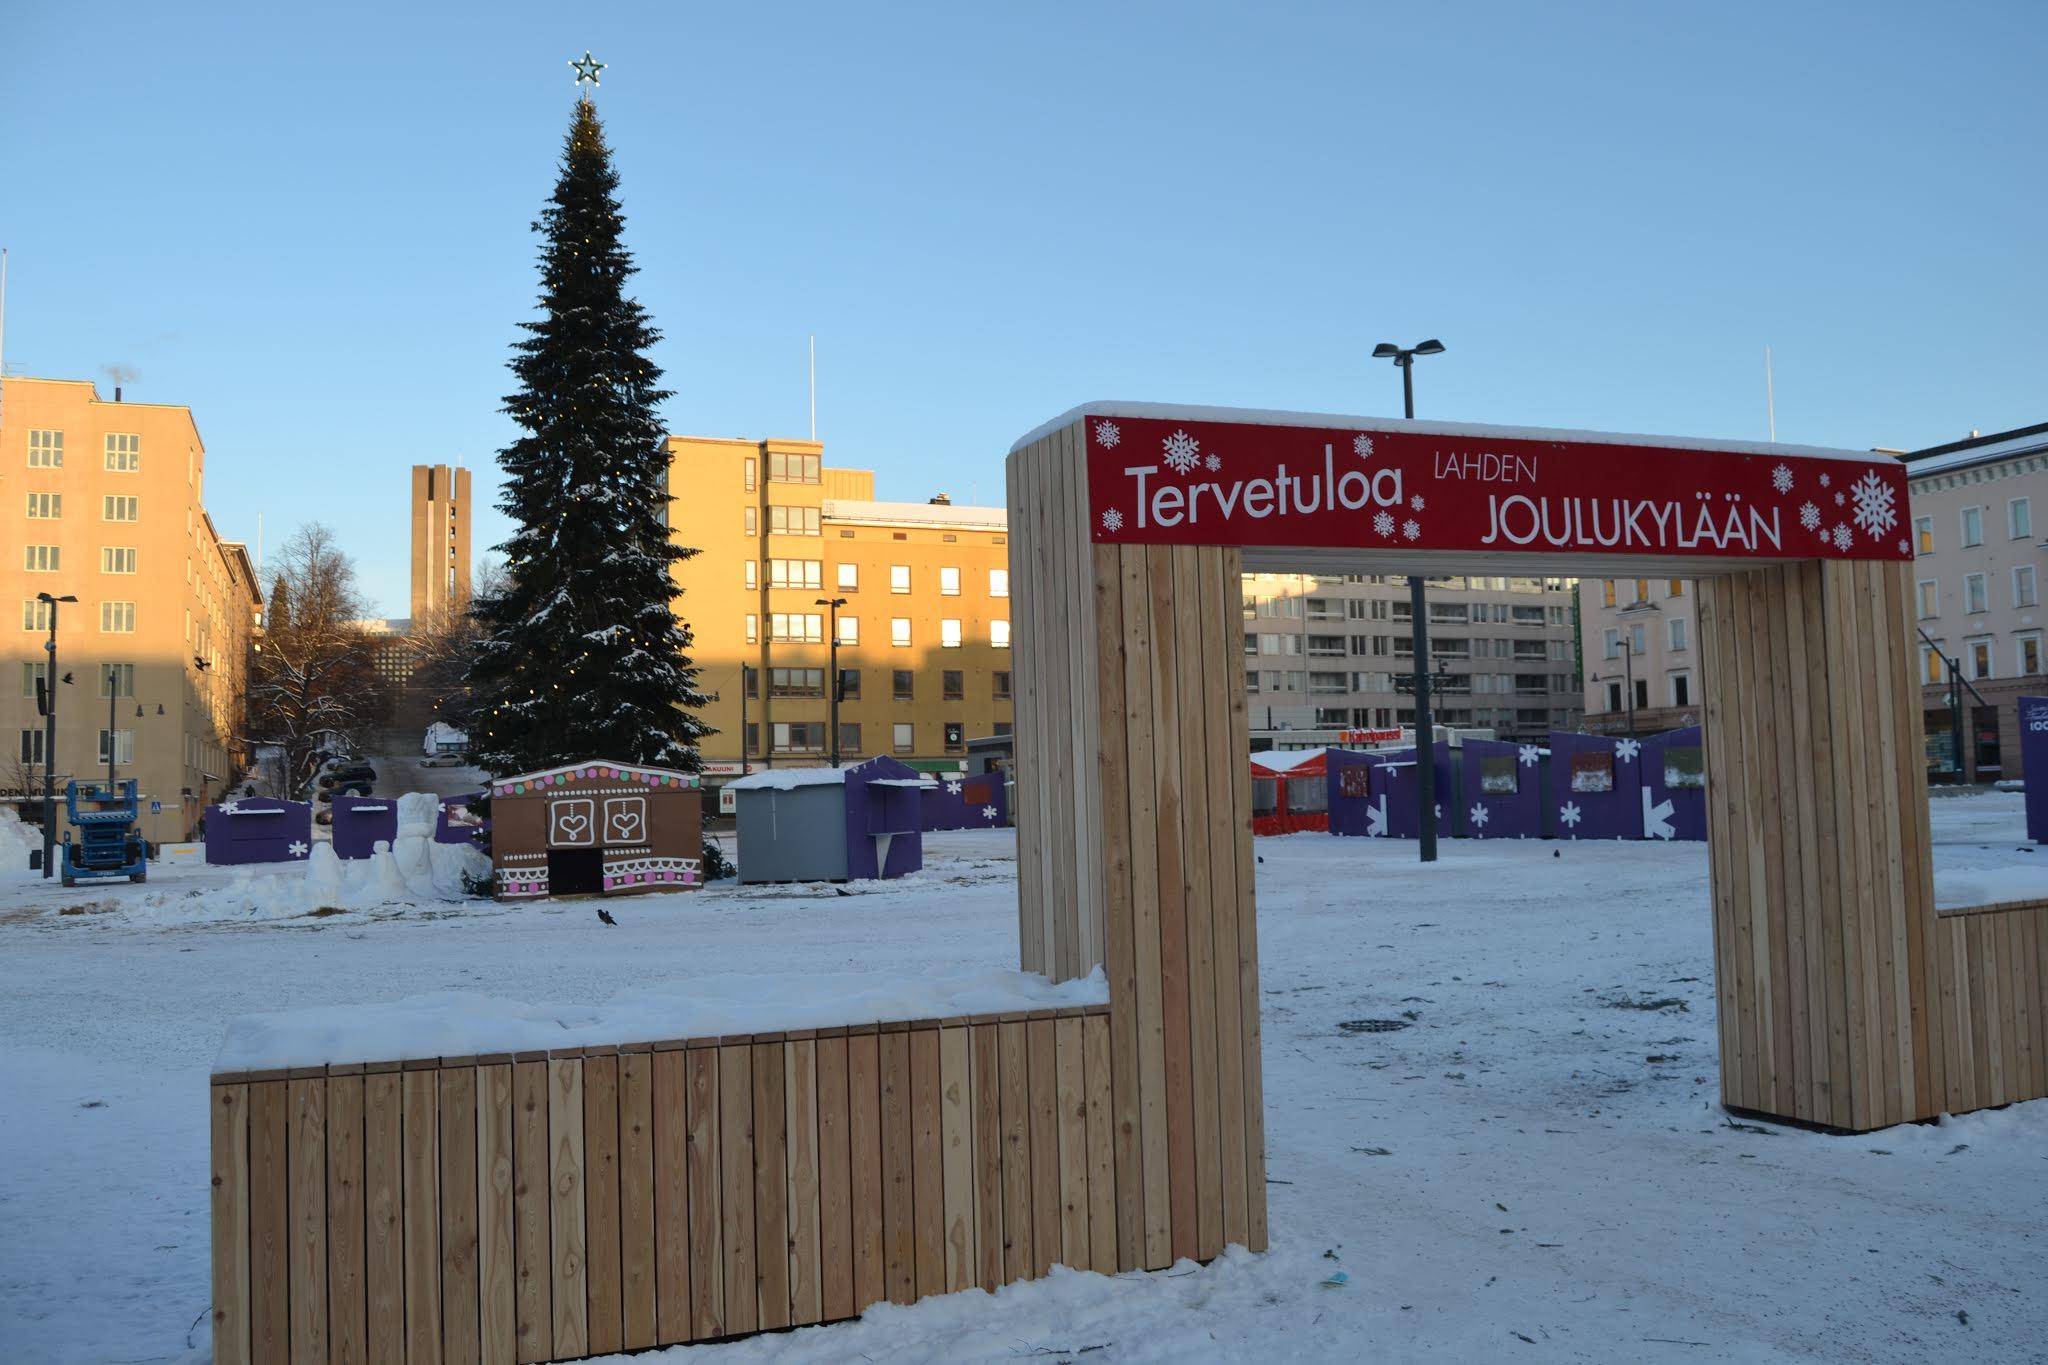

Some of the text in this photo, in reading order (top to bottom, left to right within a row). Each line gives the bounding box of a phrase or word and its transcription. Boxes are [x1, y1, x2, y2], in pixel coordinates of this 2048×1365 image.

[1124, 443, 1403, 528] Tervetuloa
[1435, 451, 1537, 483] LAHDEN
[1482, 492, 1782, 551] JOULUKYLÄÄN
